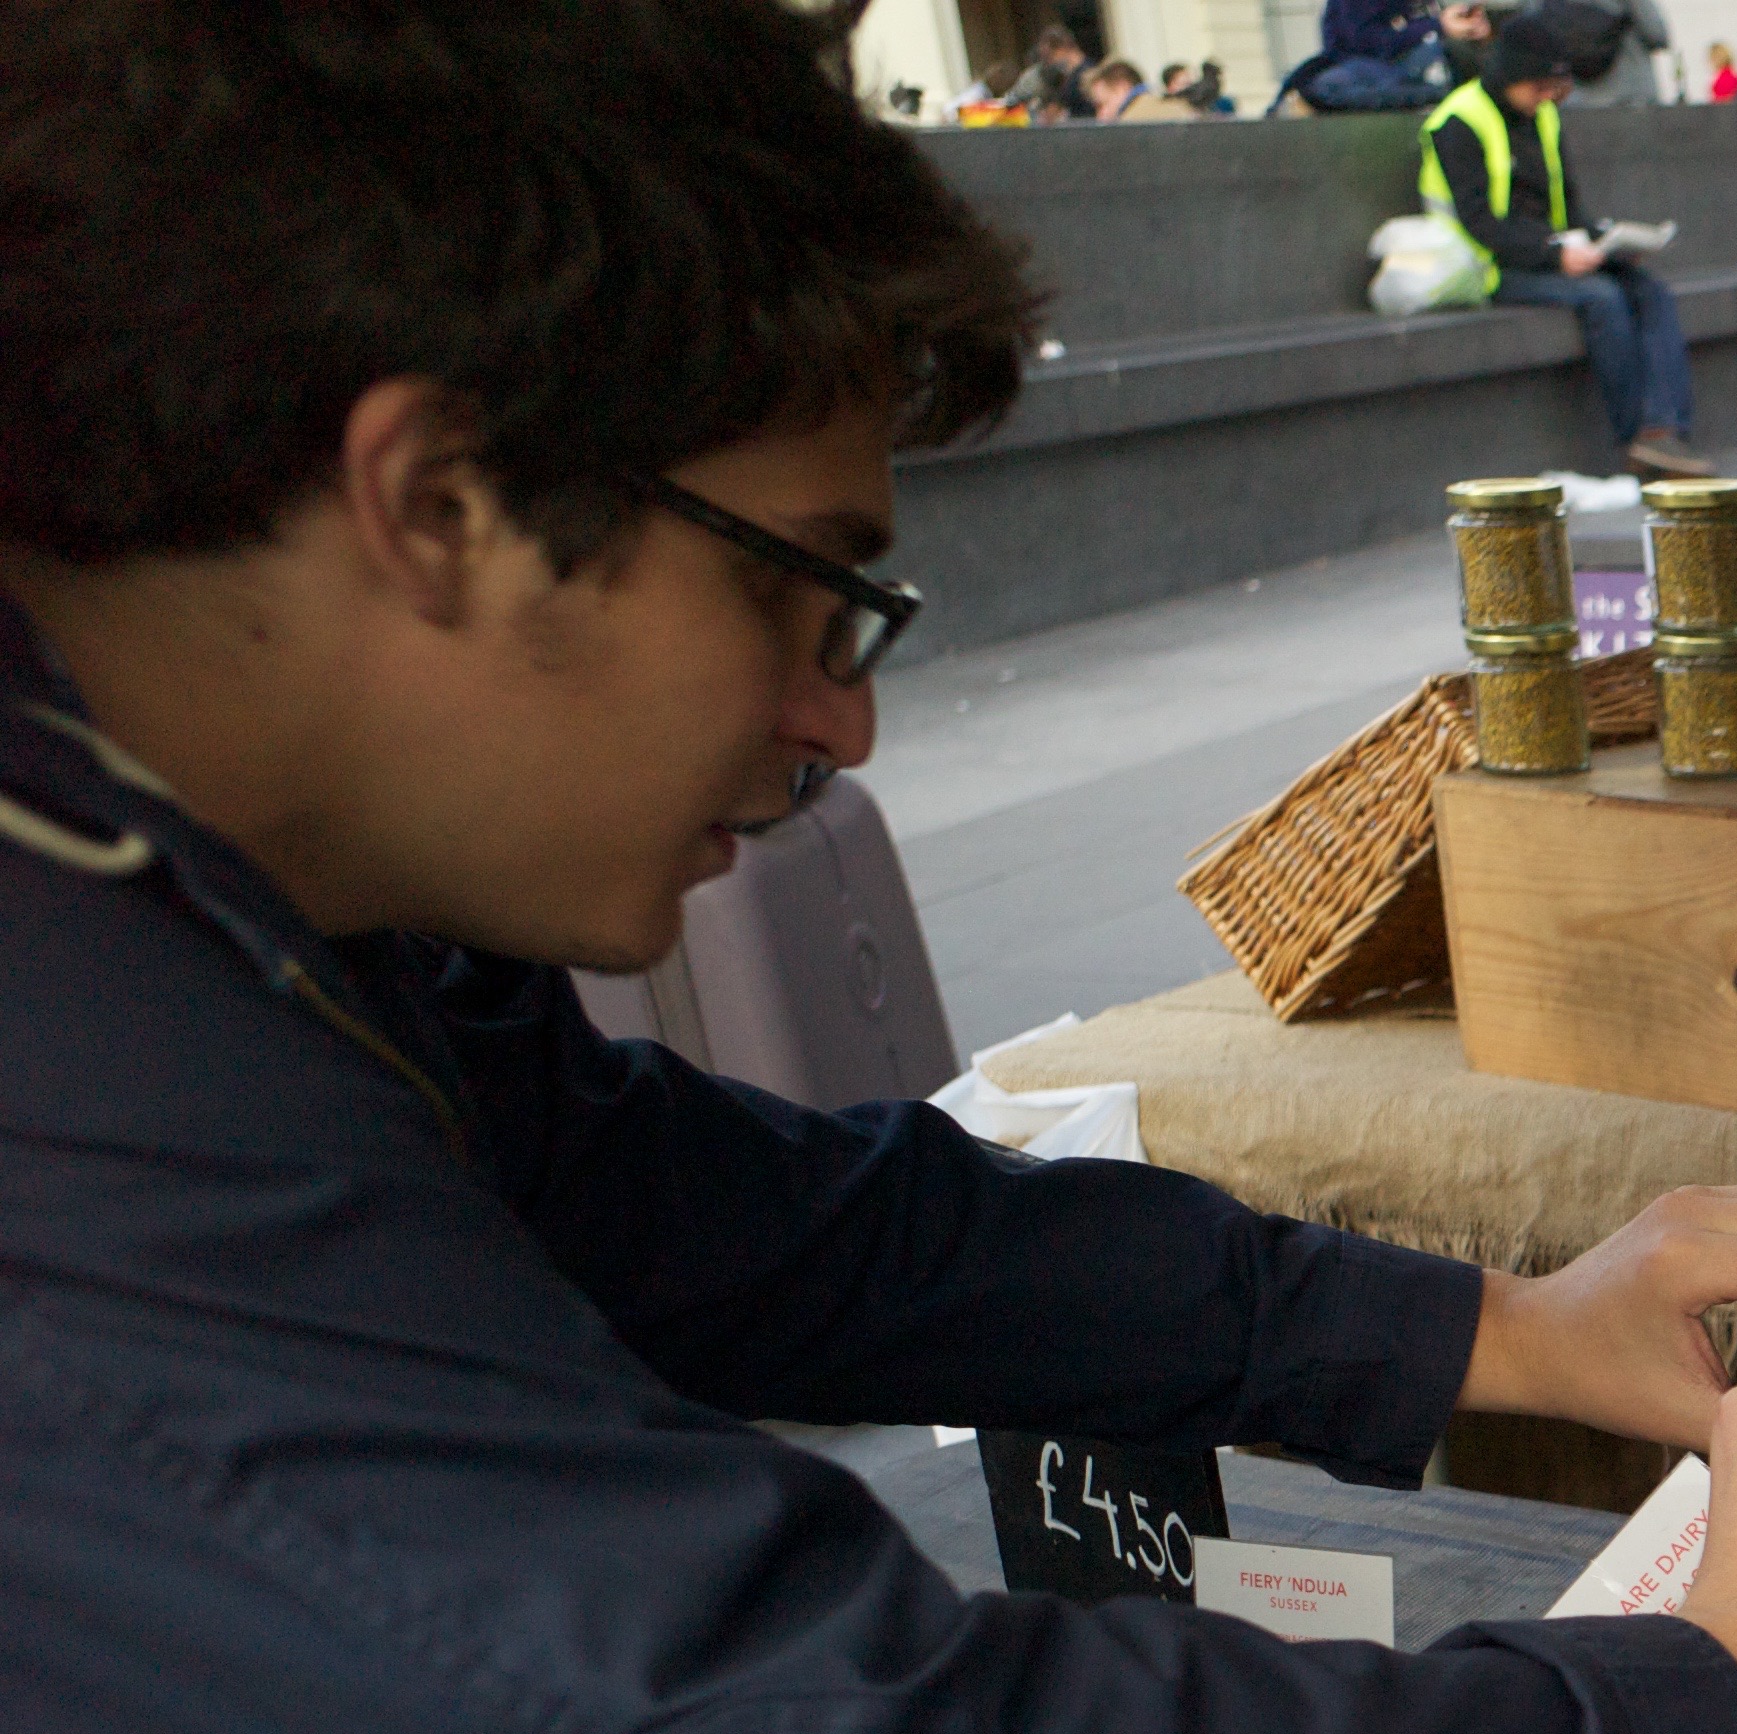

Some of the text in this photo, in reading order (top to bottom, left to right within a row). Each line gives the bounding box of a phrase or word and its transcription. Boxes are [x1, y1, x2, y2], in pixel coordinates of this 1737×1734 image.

[1036, 1440, 1194, 1587] £4.50
[1240, 1571, 1283, 1590] FIERY
[1269, 1596, 1318, 1612] SUSSEX
